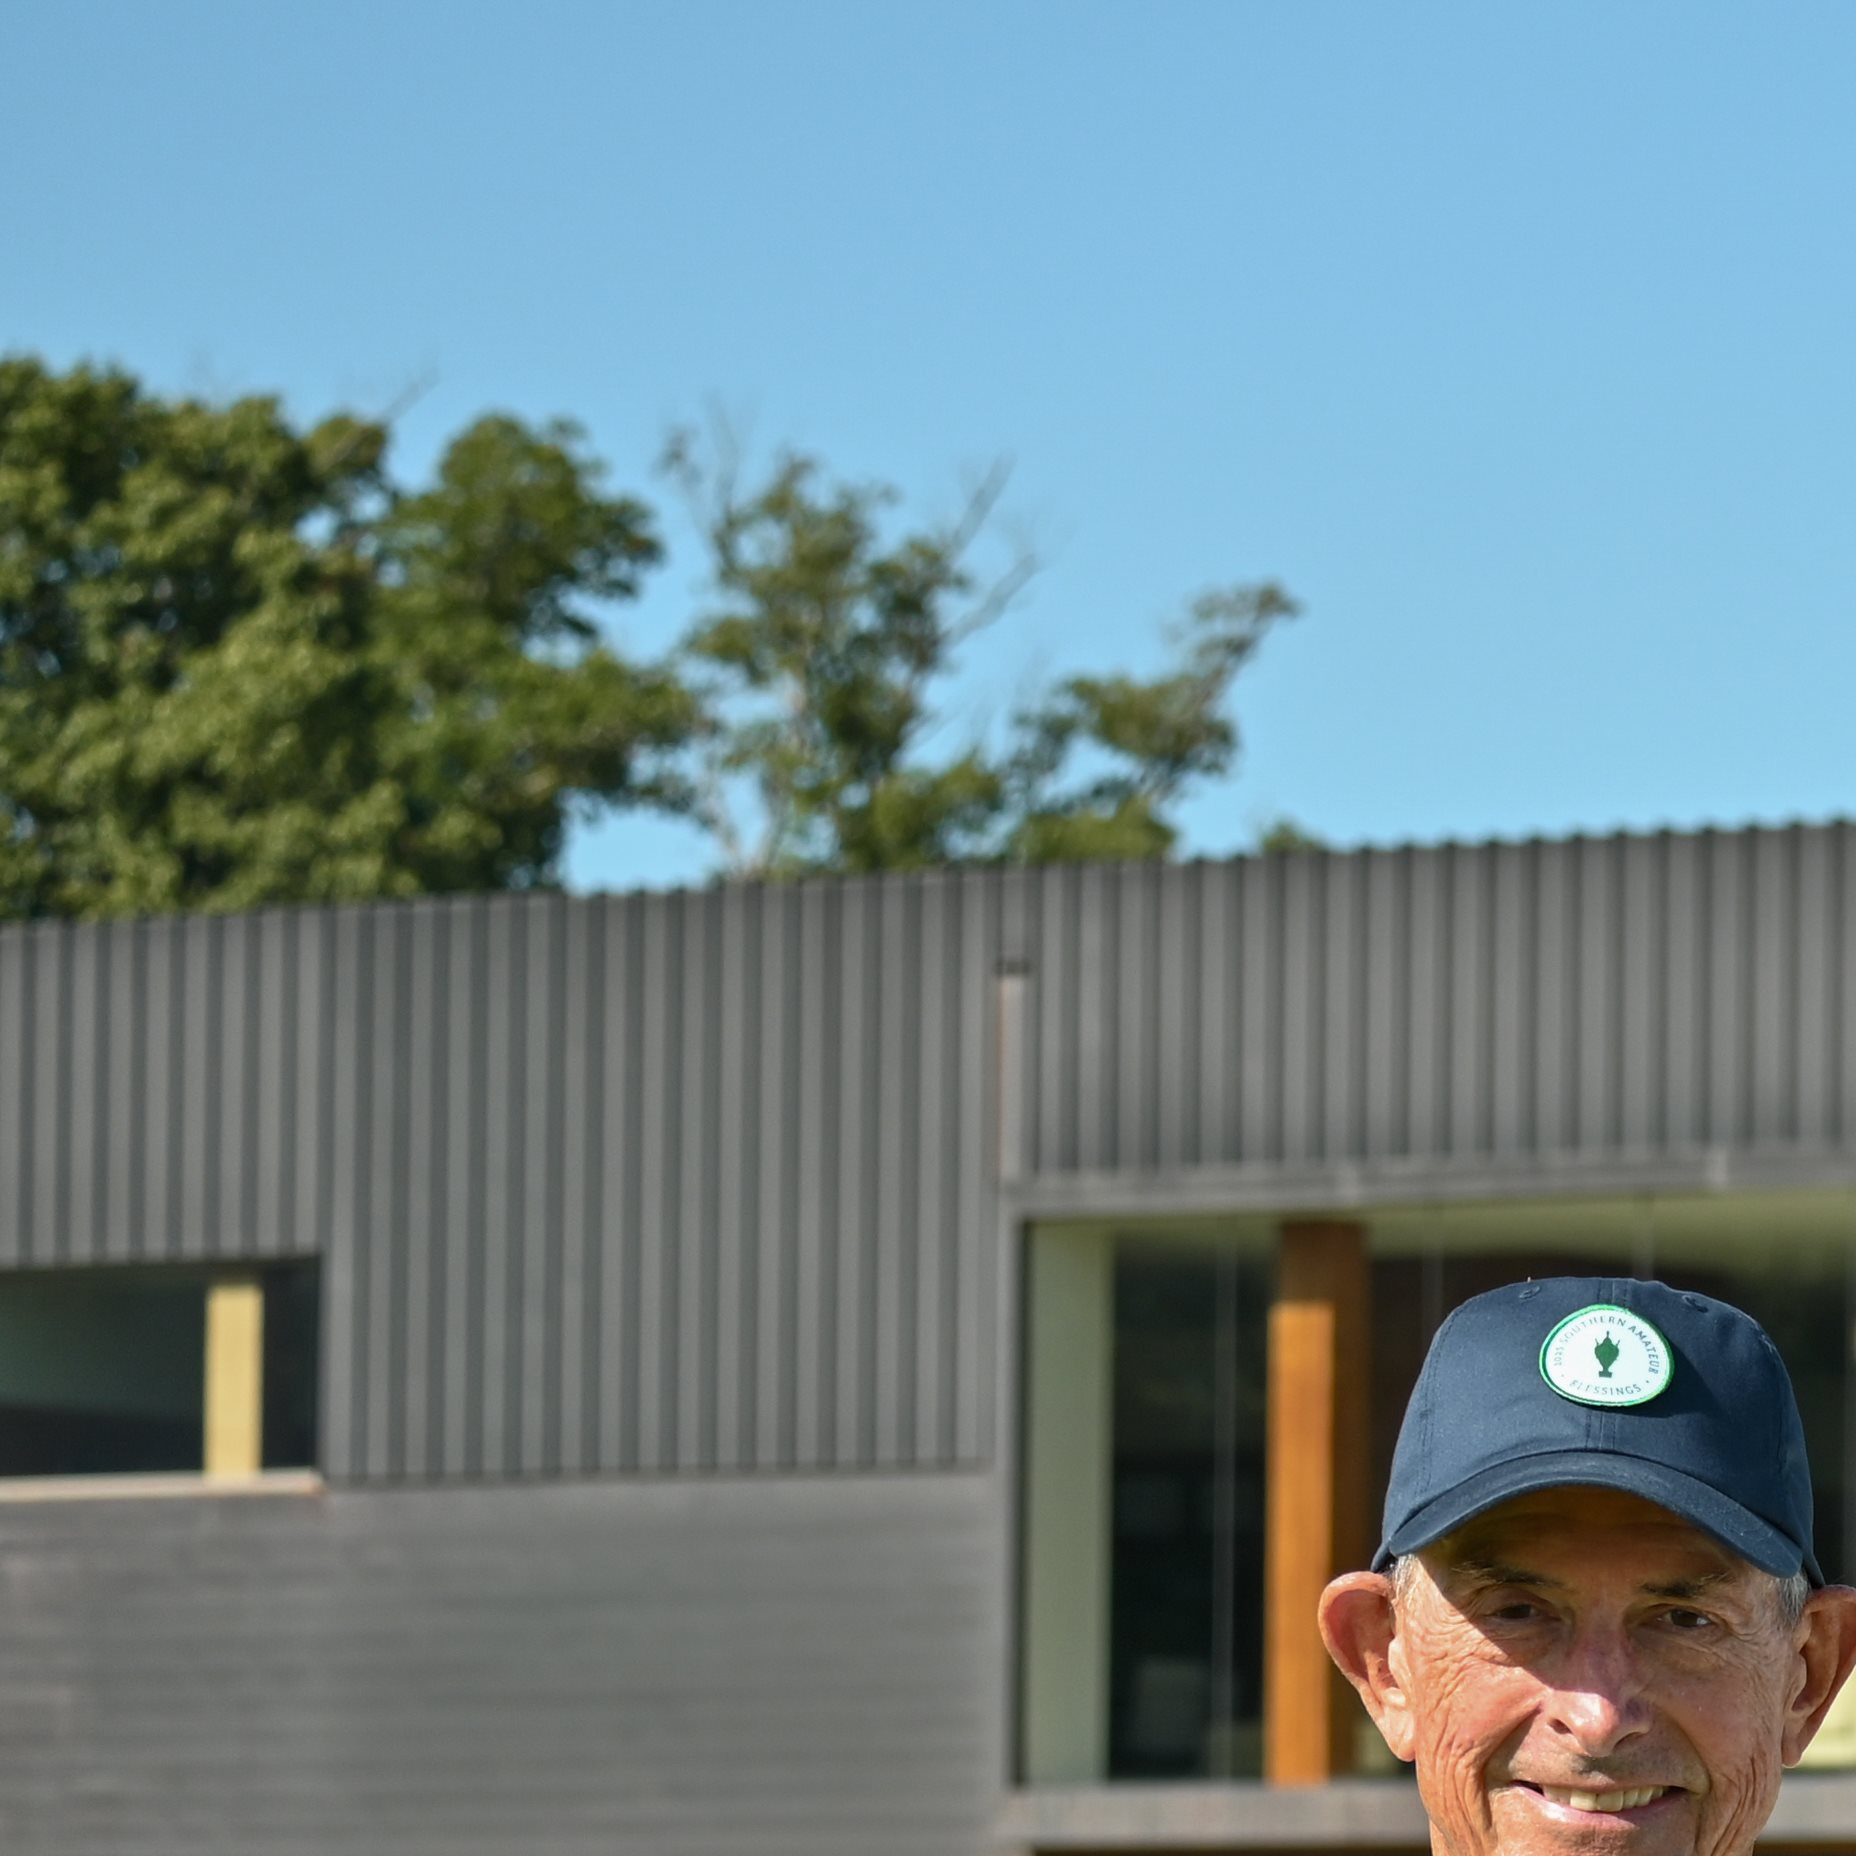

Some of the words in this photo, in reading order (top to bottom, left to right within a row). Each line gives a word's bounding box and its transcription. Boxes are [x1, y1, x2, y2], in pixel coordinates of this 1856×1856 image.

[1558, 1315, 1626, 1343] SOUTHERN
[1628, 1324, 1660, 1375] AMATEUR
[1569, 1379, 1641, 1396] BLESSINGS
